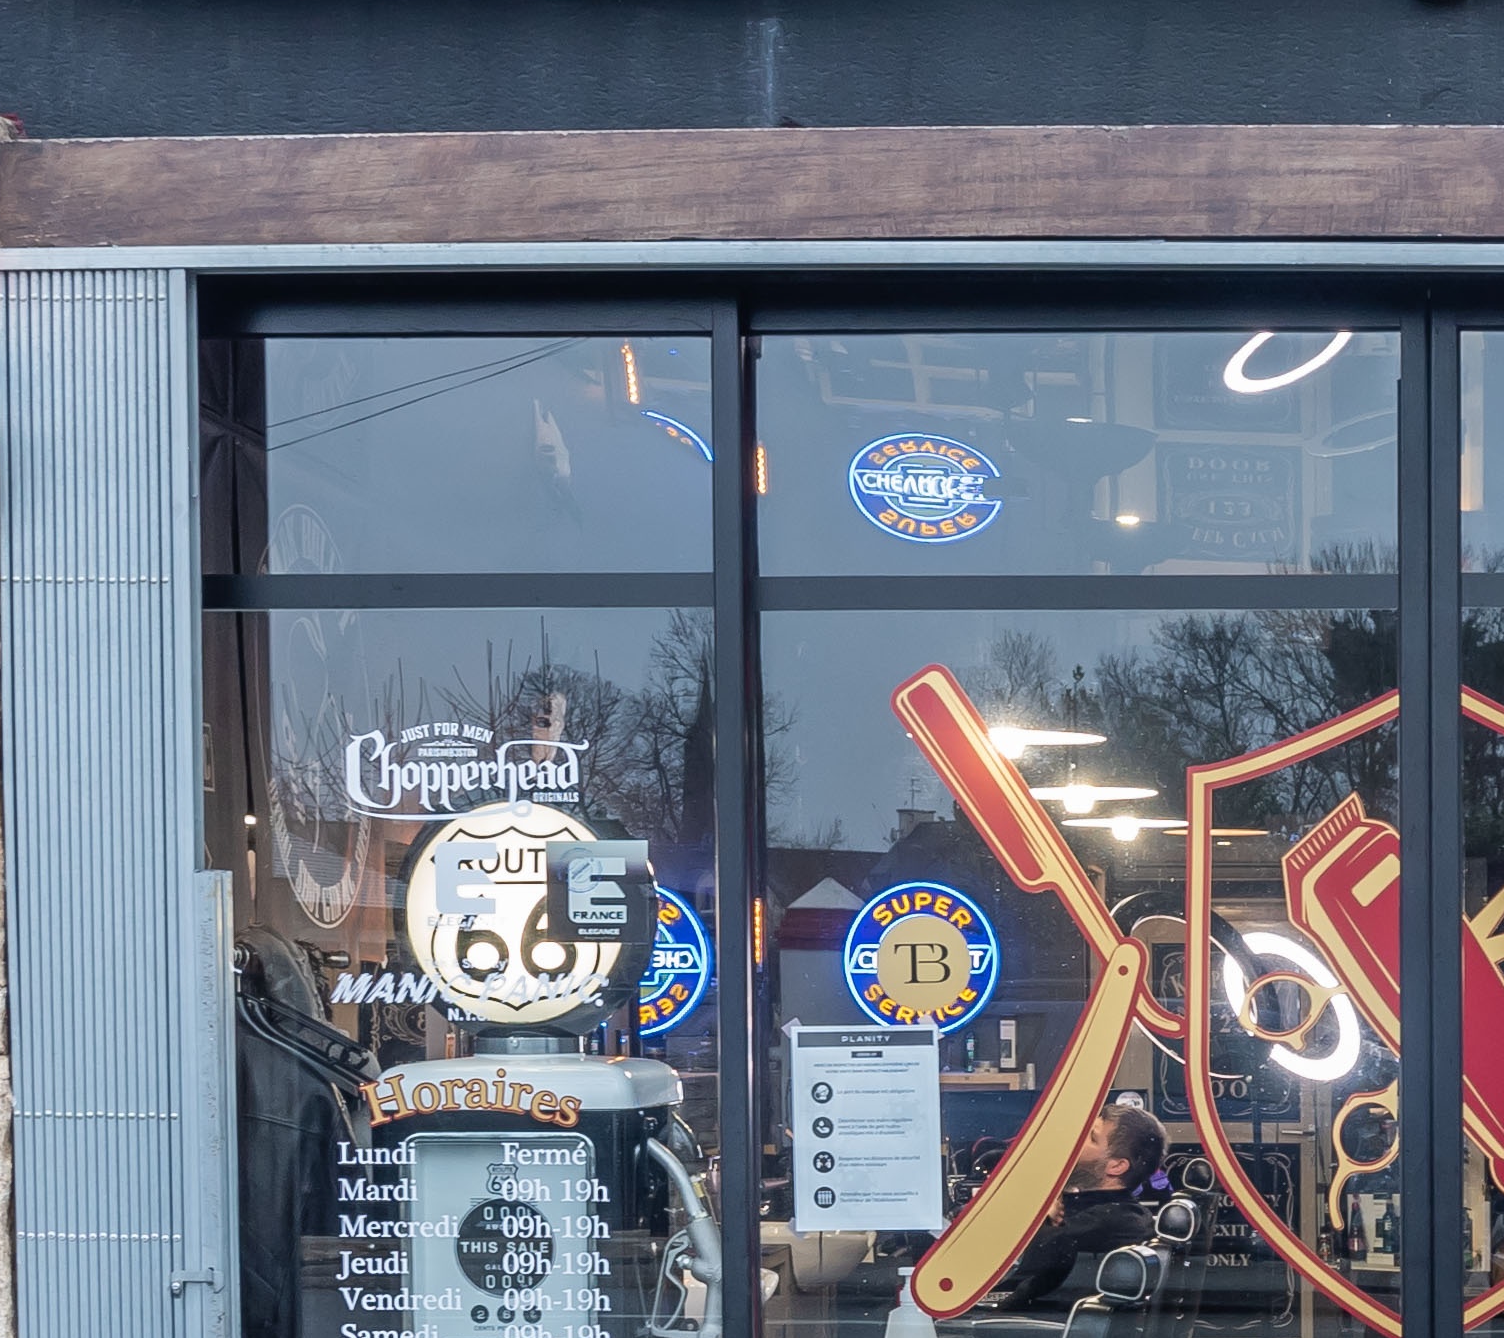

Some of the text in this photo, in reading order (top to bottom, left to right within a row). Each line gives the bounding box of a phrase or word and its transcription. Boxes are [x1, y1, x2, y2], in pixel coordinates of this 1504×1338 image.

[401, 722, 494, 744] JUST FOR MEN
[345, 729, 589, 821] Chopperhead
[533, 791, 580, 803] ORIGINALS
[456, 848, 547, 874] ROUT
[573, 911, 624, 920] FRANCE
[872, 891, 973, 930] SUPER
[840, 1034, 891, 1043] PLANITY
[359, 1068, 583, 1128] Horaires
[336, 1141, 587, 1166] Lundi Fermé
[337, 1178, 418, 1202] Mardi
[560, 1178, 611, 1203] 19h
[338, 1214, 611, 1239] Mercredi 09h-19h
[460, 1241, 550, 1255] THIS SALE
[335, 1250, 611, 1280] Jeudi 09h-19h
[340, 1287, 612, 1312] Vendredi 09h-19h
